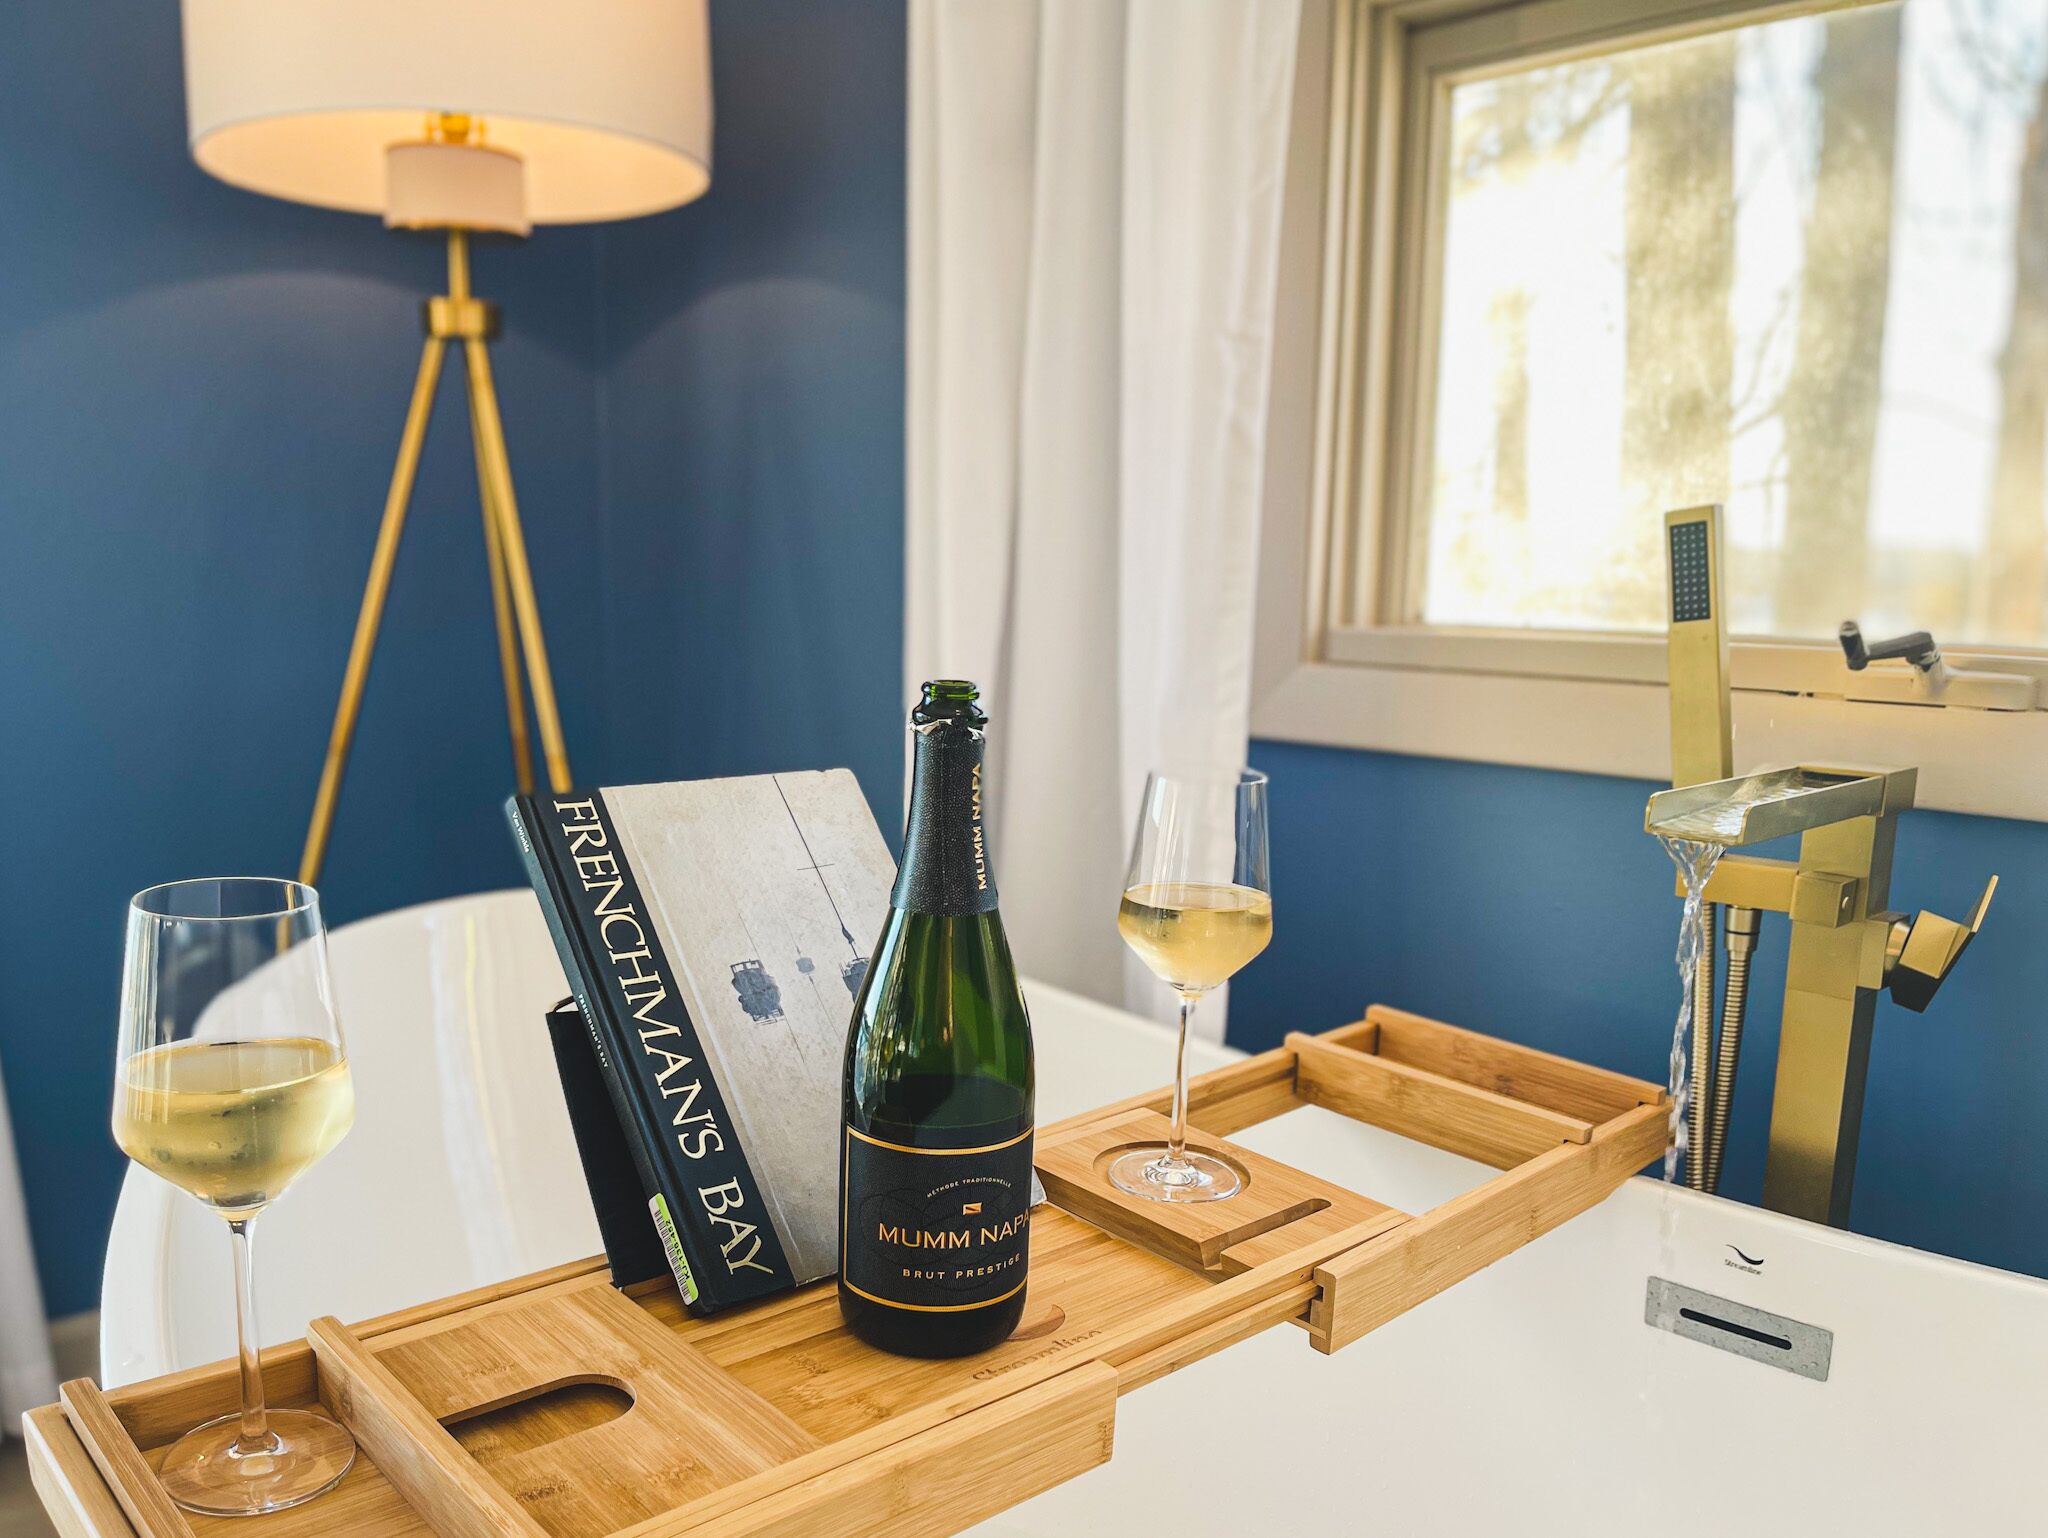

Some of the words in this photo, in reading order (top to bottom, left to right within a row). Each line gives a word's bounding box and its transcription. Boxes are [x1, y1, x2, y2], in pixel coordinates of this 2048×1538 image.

[971, 763, 982, 821] NAPA
[512, 811, 521, 827] Van
[517, 826, 530, 852] Winkle
[973, 825, 987, 890] MUMM
[553, 798, 725, 1159] FRENCHMAN'S
[697, 1176, 774, 1276] BAY
[578, 993, 601, 1050] FRENCHMAN'S
[599, 1050, 608, 1068] BAY
[962, 1176, 1012, 1188] TRADITIONNELLE
[878, 1222, 971, 1249] MUMM
[980, 1208, 1030, 1246] NAPA
[903, 1268, 945, 1280] BRUT
[956, 1253, 1020, 1279] PRESTIGE
[1724, 1258, 1762, 1275] Streamline
